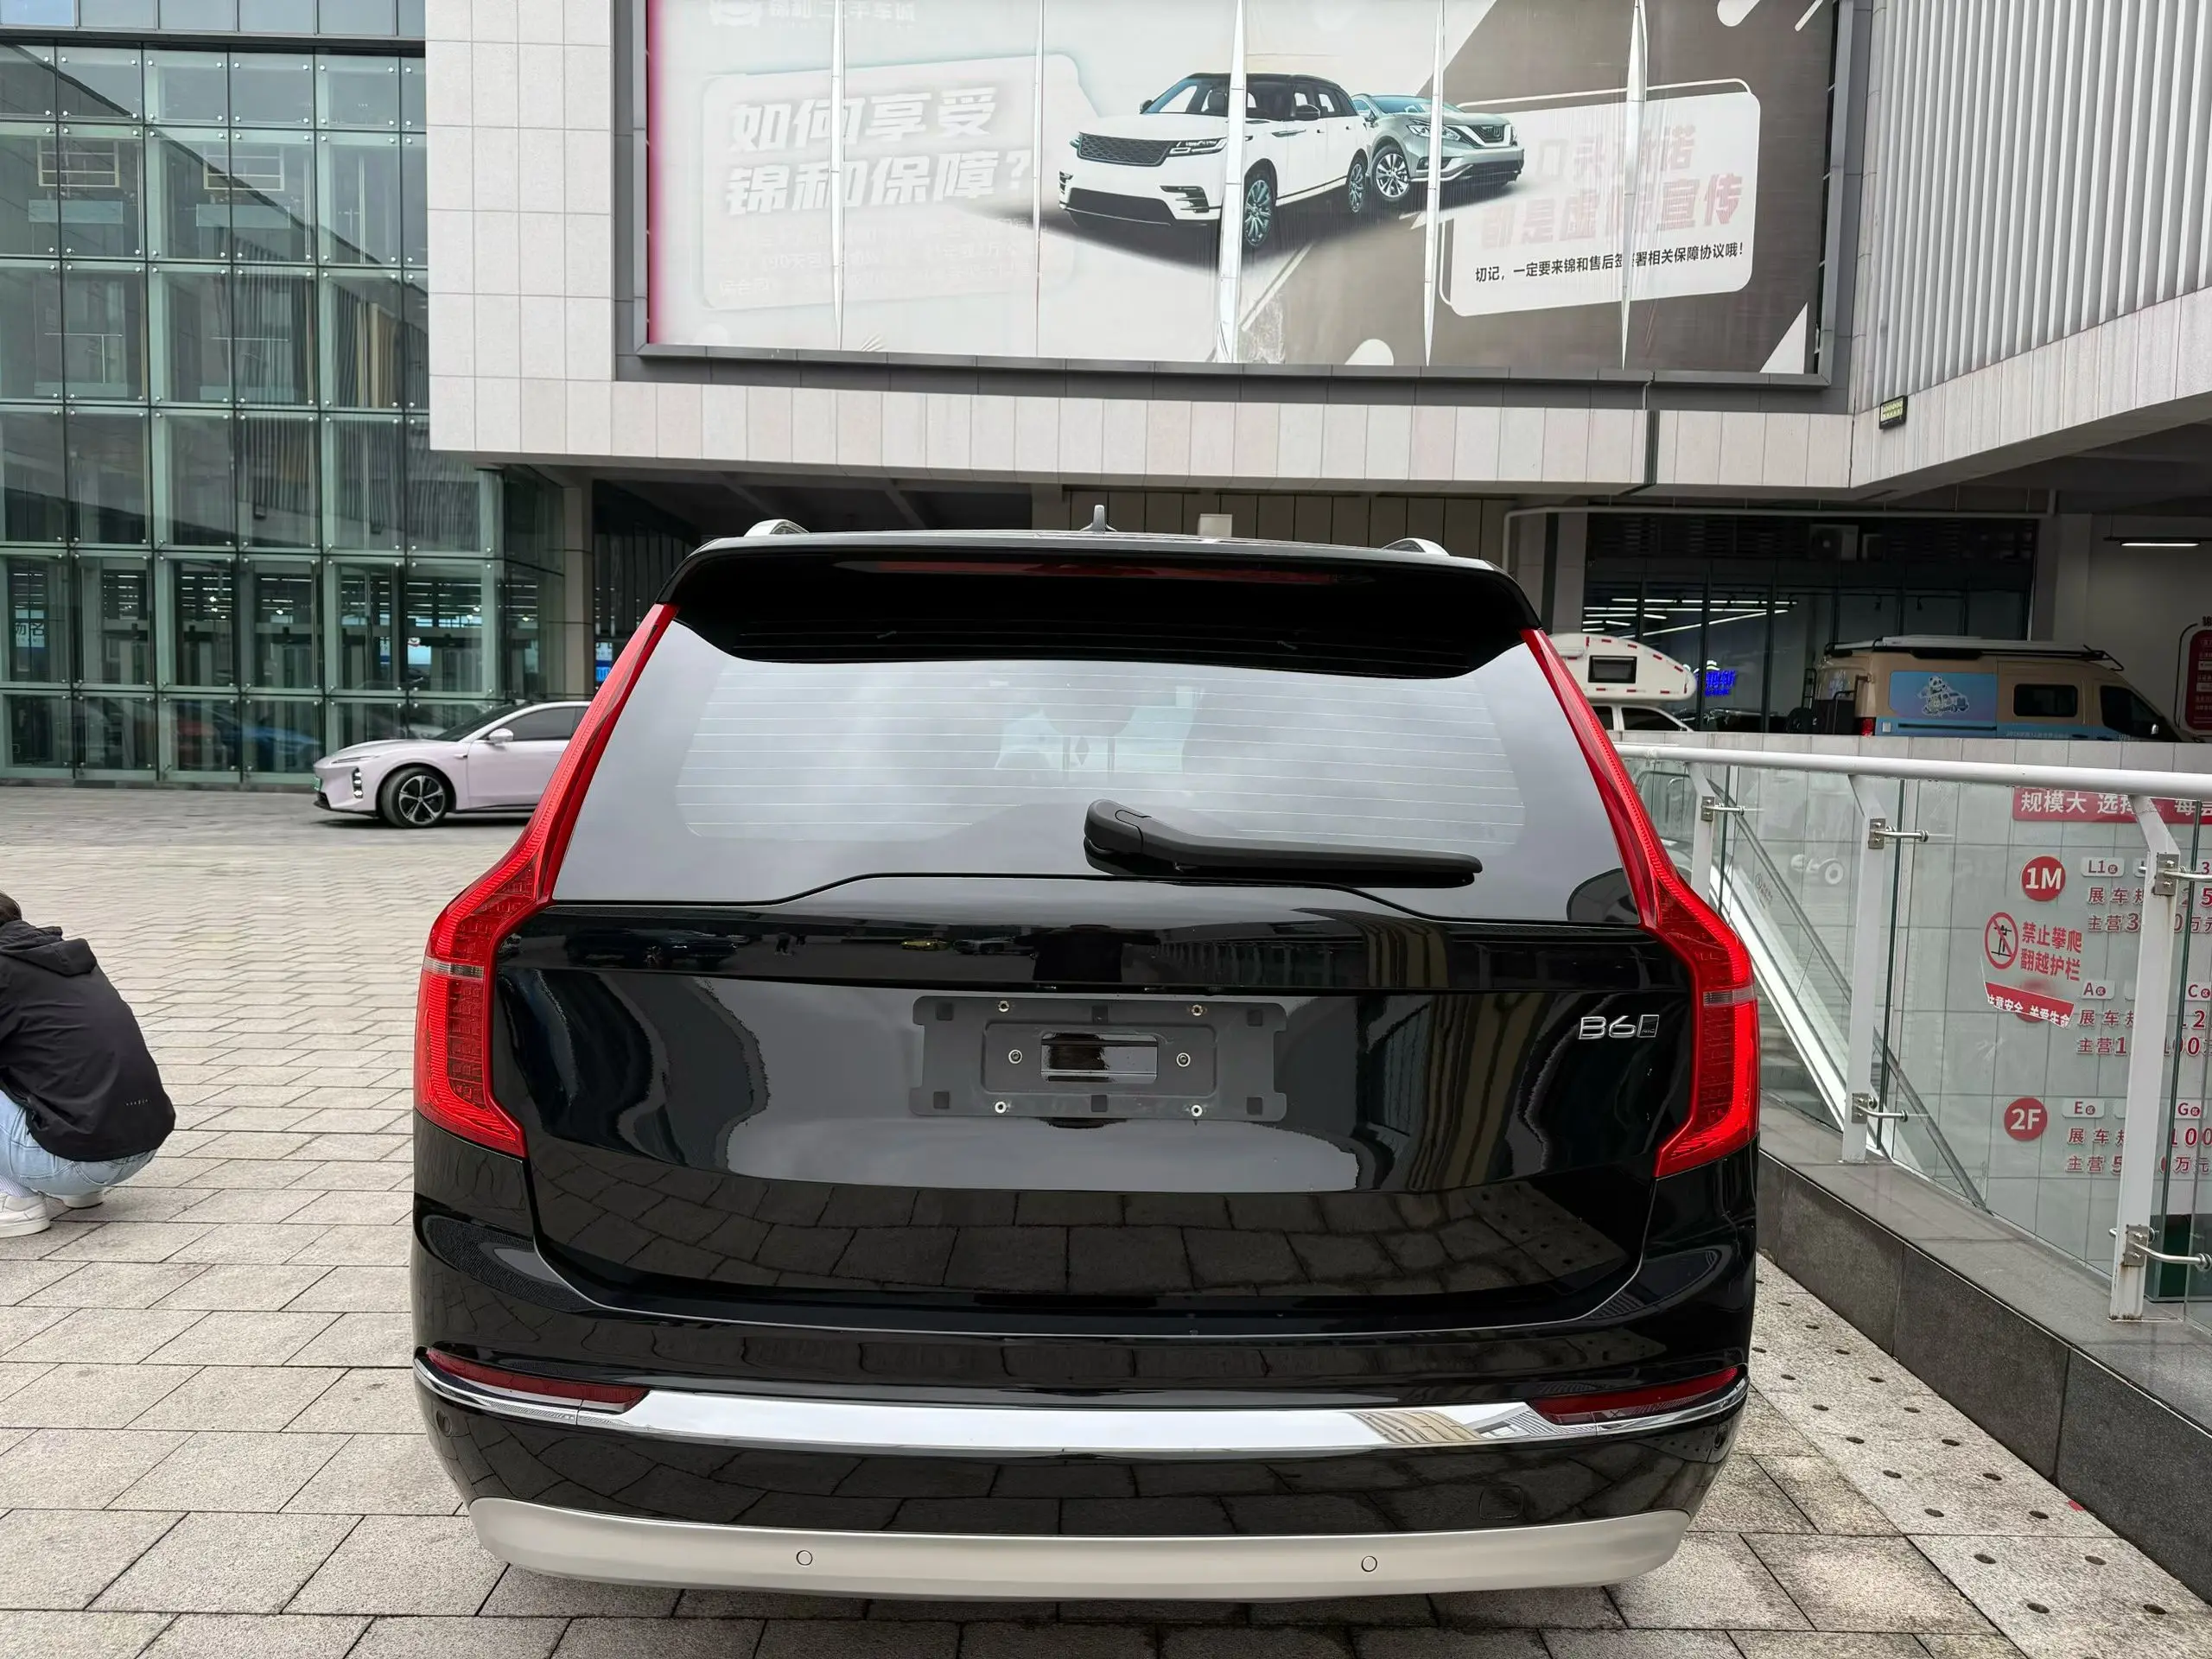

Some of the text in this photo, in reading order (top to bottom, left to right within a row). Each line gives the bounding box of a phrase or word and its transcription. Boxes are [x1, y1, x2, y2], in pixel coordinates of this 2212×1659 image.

[730, 86, 997, 152] 如何享受
[2021, 791, 2087, 812] 规模大
[2025, 867, 2062, 890] 1M
[2022, 921, 2082, 954] 禁止攀爬
[2020, 948, 2081, 982] 翻越护栏
[1578, 1015, 1636, 1040] B6
[2011, 1108, 2041, 1131] 2F
